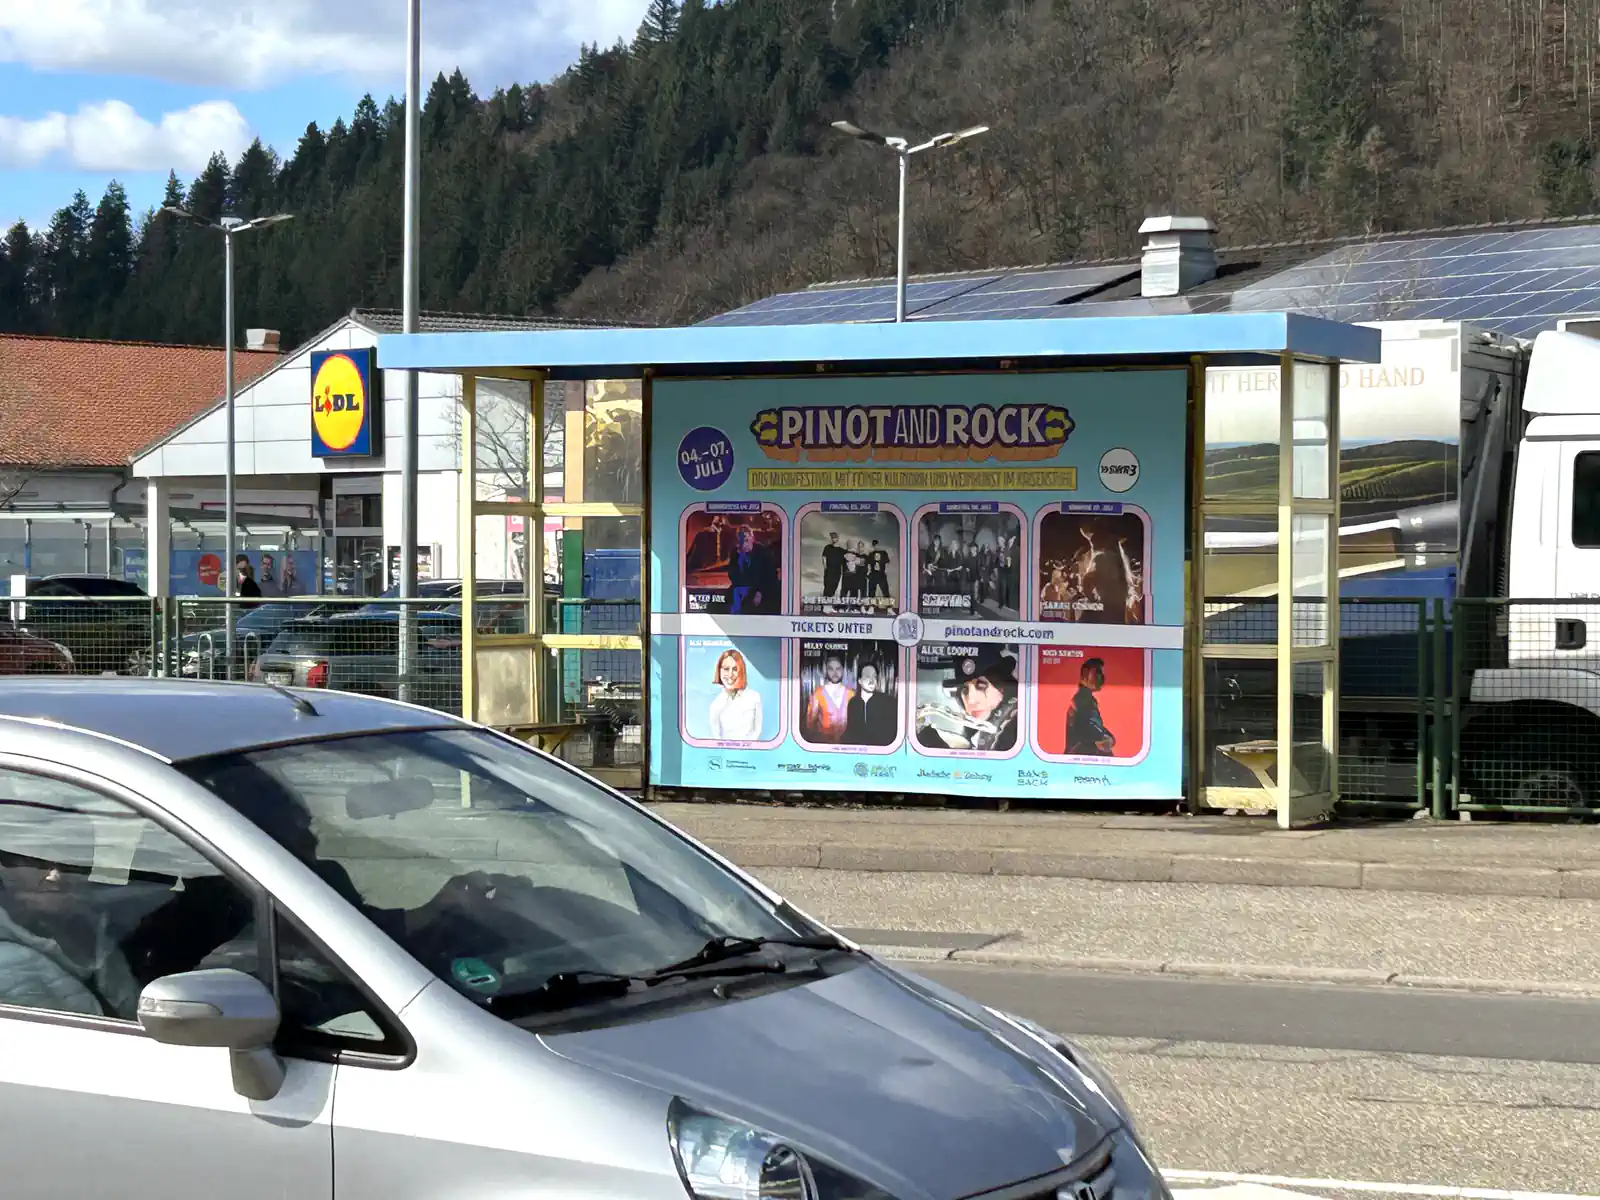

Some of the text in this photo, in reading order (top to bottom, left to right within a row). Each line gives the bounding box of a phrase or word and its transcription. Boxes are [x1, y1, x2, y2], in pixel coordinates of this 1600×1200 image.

[1359, 366, 1425, 388] HAND
[315, 387, 360, 415] LIDL
[781, 406, 1047, 445] PINOT AND ROCK
[693, 458, 724, 479] JULI
[791, 620, 873, 635] TICKETS UNTER
[945, 624, 1055, 640] pinotandrock.com
